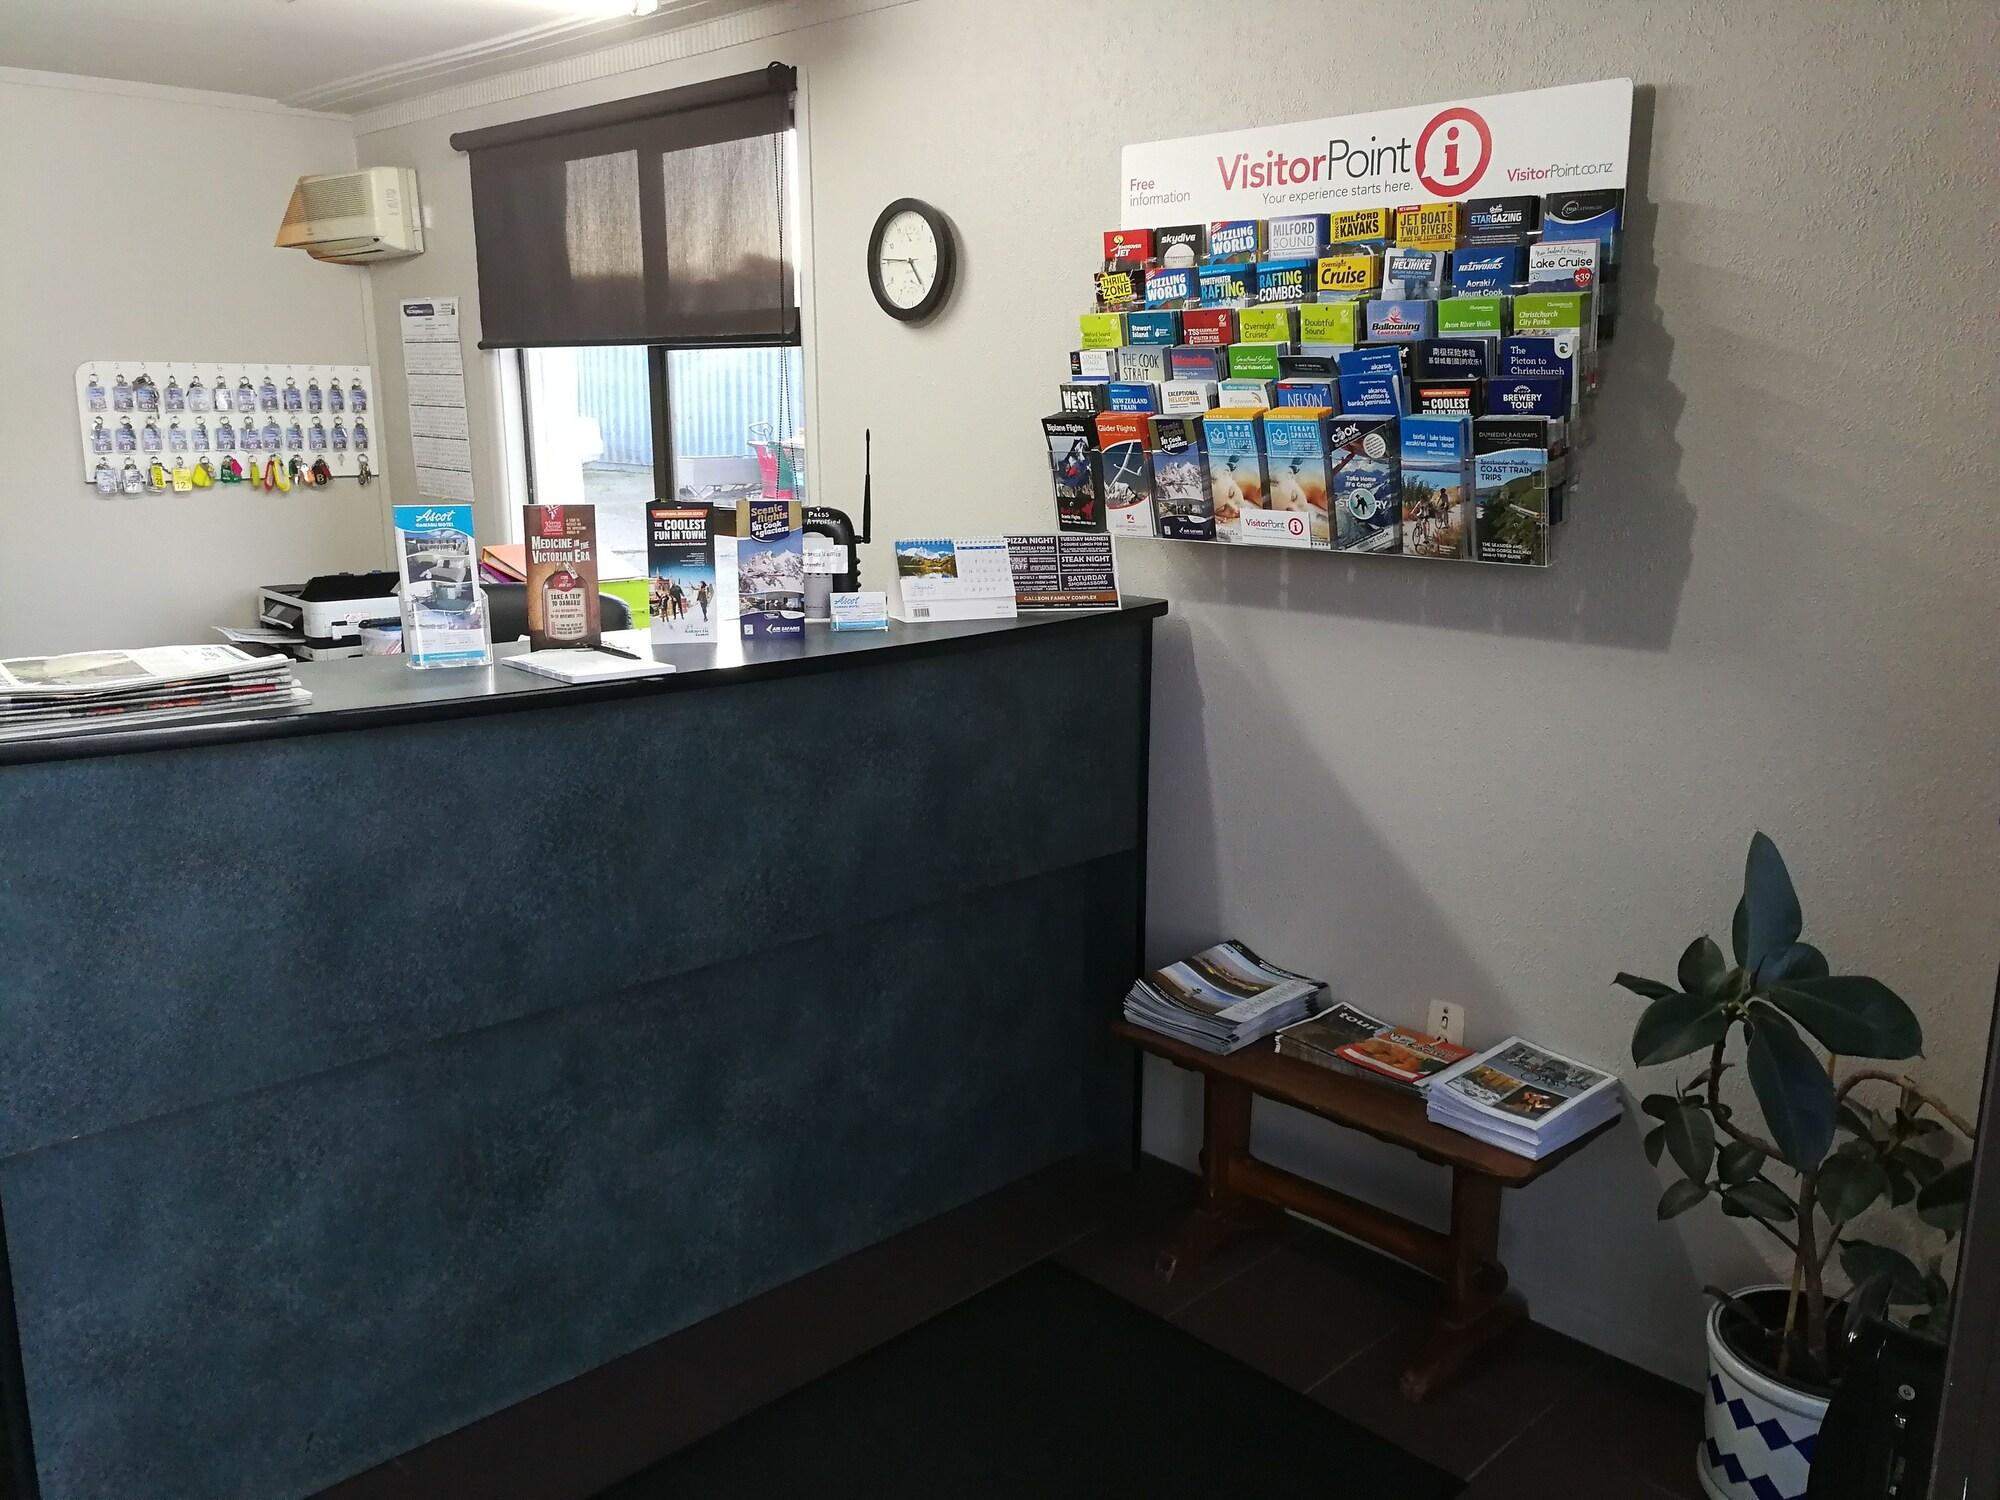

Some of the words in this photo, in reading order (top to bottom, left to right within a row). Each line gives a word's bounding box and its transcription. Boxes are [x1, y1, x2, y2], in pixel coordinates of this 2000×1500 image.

[1217, 136, 1411, 191] VisitorPoint
[1507, 161, 1613, 182] VisitorPoint.co.nz
[1130, 178, 1155, 192] Free
[1130, 190, 1191, 207] information
[1262, 191, 1286, 205] Your
[1288, 186, 1348, 204] experience
[1351, 184, 1381, 197] starts
[1384, 181, 1414, 194] here.
[1339, 212, 1379, 224] MILFORD
[1400, 213, 1419, 226] JET
[1421, 211, 1447, 224] BOAT
[1471, 213, 1522, 224] STARGAZING
[1212, 226, 1253, 242] PUZZLING
[1273, 222, 1314, 236] MILFORD
[1340, 219, 1379, 237] KAYAKS
[1400, 226, 1419, 236] TWO
[1421, 222, 1452, 234] RIVERS
[1161, 233, 1196, 244] skydive
[1273, 235, 1314, 248] SOUND
[1212, 237, 1254, 255] WORLD
[1115, 249, 1130, 257] JET
[1392, 260, 1432, 271] HELIHIKE
[1531, 258, 1555, 268] Lake
[1558, 257, 1592, 267] Cruise
[1101, 274, 1129, 286] THRILL
[1146, 273, 1186, 289] PUZZLING
[1259, 270, 1302, 288] RAFTING
[1321, 266, 1366, 284] Cruise
[1575, 273, 1590, 281] $39
[1201, 281, 1245, 298] RAFTING
[1466, 279, 1490, 288] Aoraki
[1103, 283, 1130, 297] ZONE
[1147, 284, 1187, 301] WORLD
[1260, 285, 1302, 301] COMBOS
[1458, 289, 1481, 297] Mount
[1483, 288, 1503, 296] Cook
[1244, 322, 1275, 331] Overnight
[1305, 319, 1334, 327] Doubtful
[1372, 322, 1420, 331] Ballooning
[1305, 327, 1325, 335] Sound
[1511, 346, 1525, 354] The
[1122, 354, 1136, 367] THE
[1139, 353, 1159, 368] COOK
[1511, 357, 1536, 366] Picton
[1124, 368, 1149, 380] STRAIT
[1511, 367, 1564, 375] Christchurch
[1288, 393, 1323, 407] NELSON
[1431, 398, 1469, 409] COOLEST
[1503, 394, 1542, 402] BREWERY
[1047, 424, 1065, 433] Biplane
[1066, 424, 1084, 433] Flights
[1116, 424, 1137, 433] Flights
[1331, 423, 1359, 443] COOK
[1481, 473, 1502, 481] TRIPS
[416, 509, 455, 521] Ascot
[751, 504, 783, 516] Scenic
[758, 512, 787, 523] flights
[1245, 519, 1285, 528] VisitorPoint
[664, 520, 706, 530] COOLEST
[763, 521, 782, 529] Cook
[654, 531, 670, 540] FUN
[672, 531, 680, 540] IN
[681, 530, 706, 539] TOWN!
[760, 526, 789, 537] glaciers
[531, 536, 572, 549] MEDICINE
[532, 551, 572, 563] VICTORIAN
[575, 549, 590, 562] ERA
[834, 596, 859, 604] Ascot
